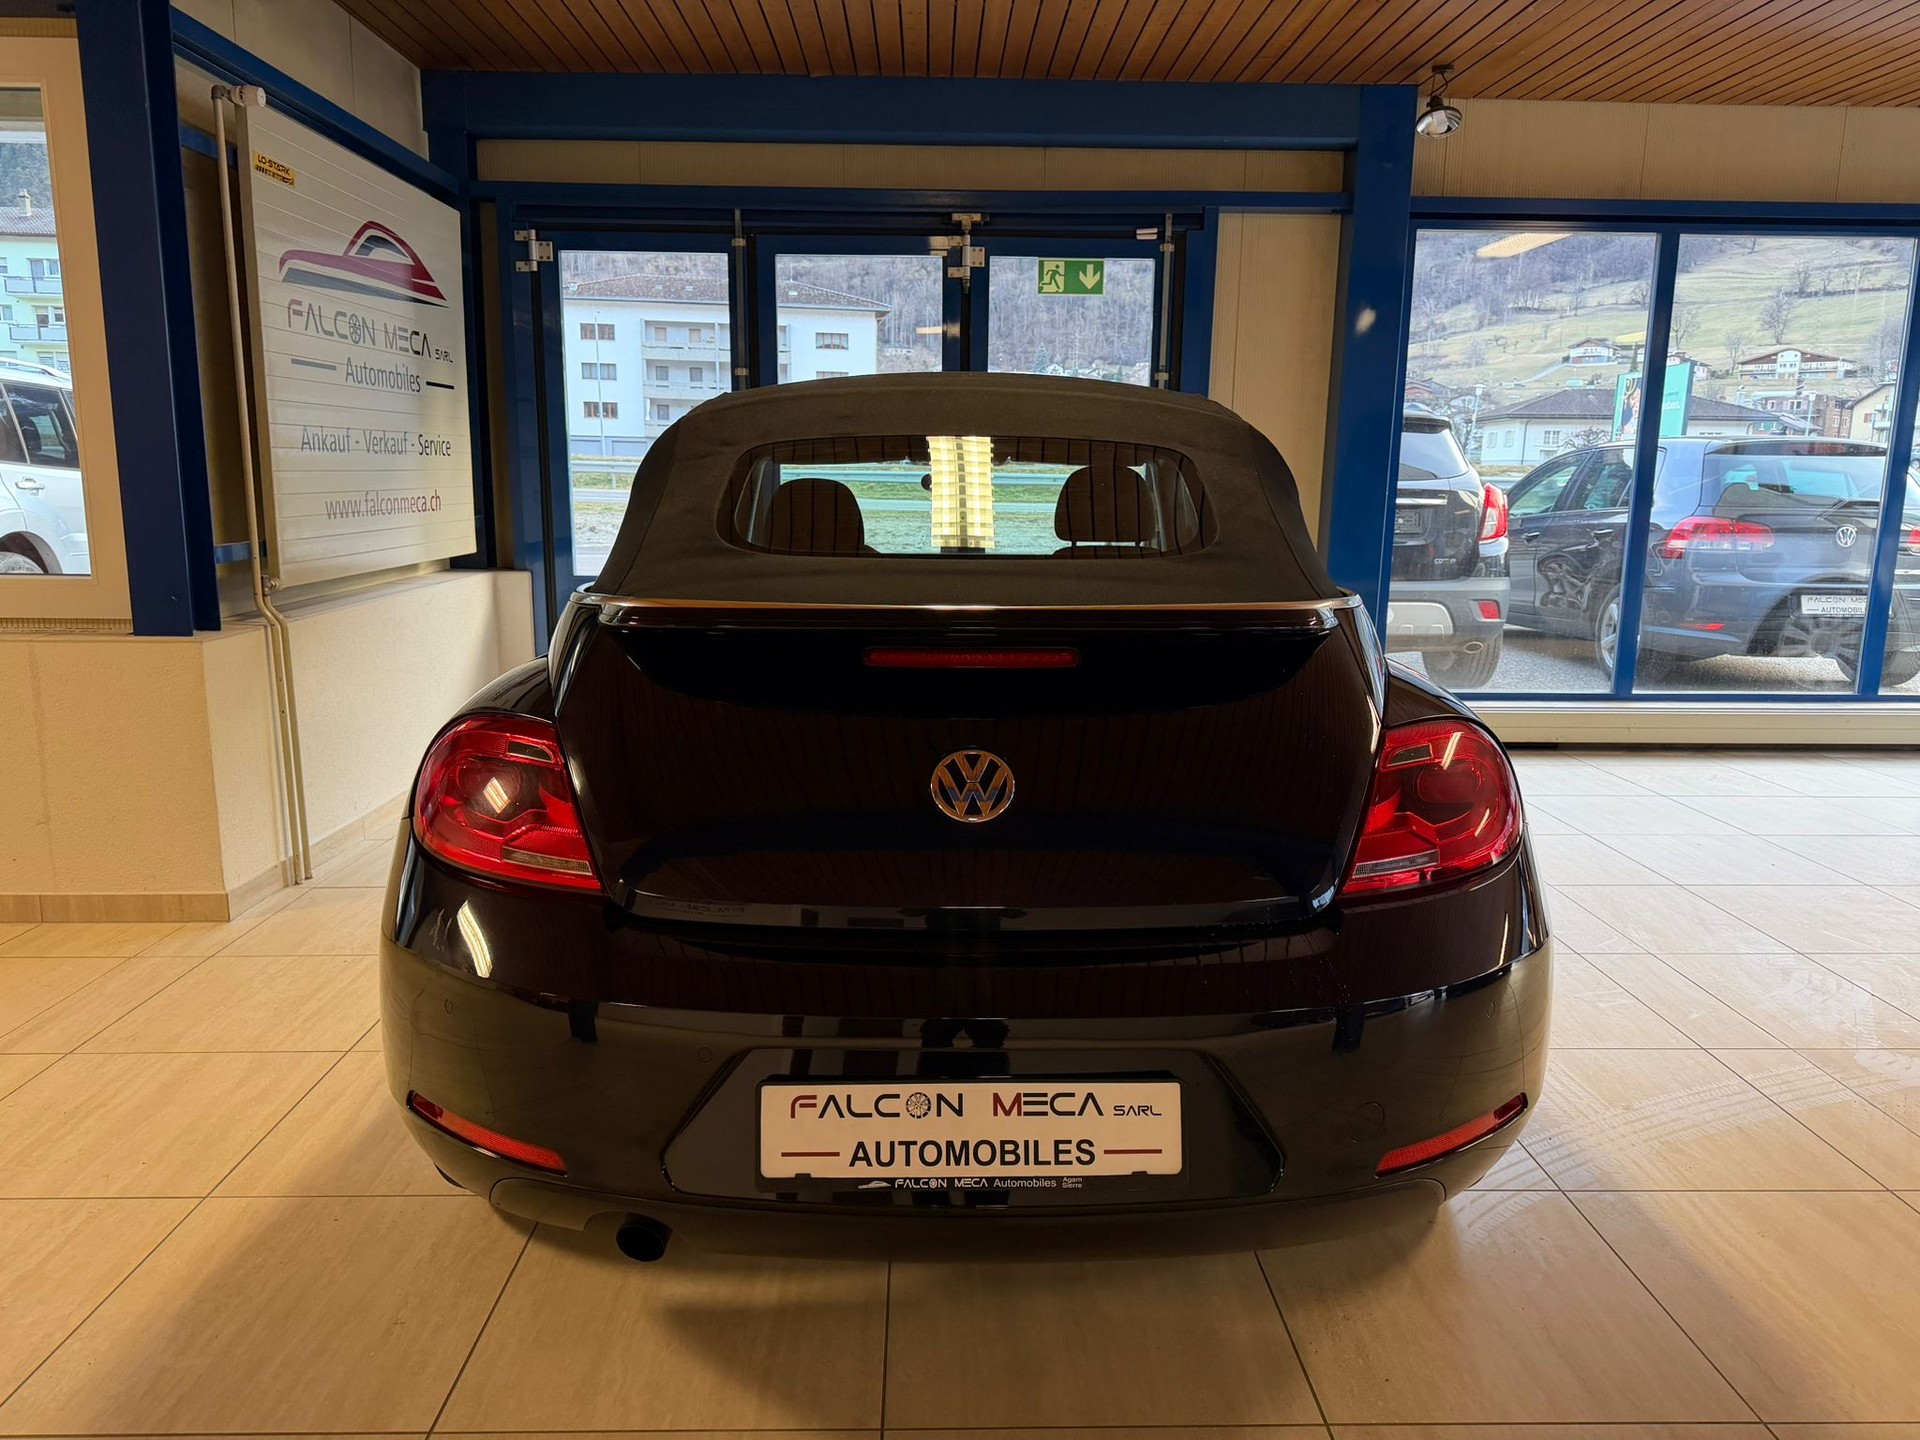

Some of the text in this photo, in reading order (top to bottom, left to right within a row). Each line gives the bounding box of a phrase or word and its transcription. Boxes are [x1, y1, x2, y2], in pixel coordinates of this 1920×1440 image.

[287, 299, 454, 364] FALCON MECA SARL
[345, 356, 421, 393] Automobiles
[301, 426, 351, 453] Ankauf
[363, 429, 408, 454] Verkauf
[418, 434, 451, 457] Service
[325, 489, 442, 520] www.falconmeca.ch
[930, 749, 1015, 823] VW
[790, 1092, 1162, 1119] FALCON MECA SARL
[849, 1139, 1096, 1168] AUTOMOBILES
[895, 1178, 1057, 1189] FALCON MECA Automobiles
